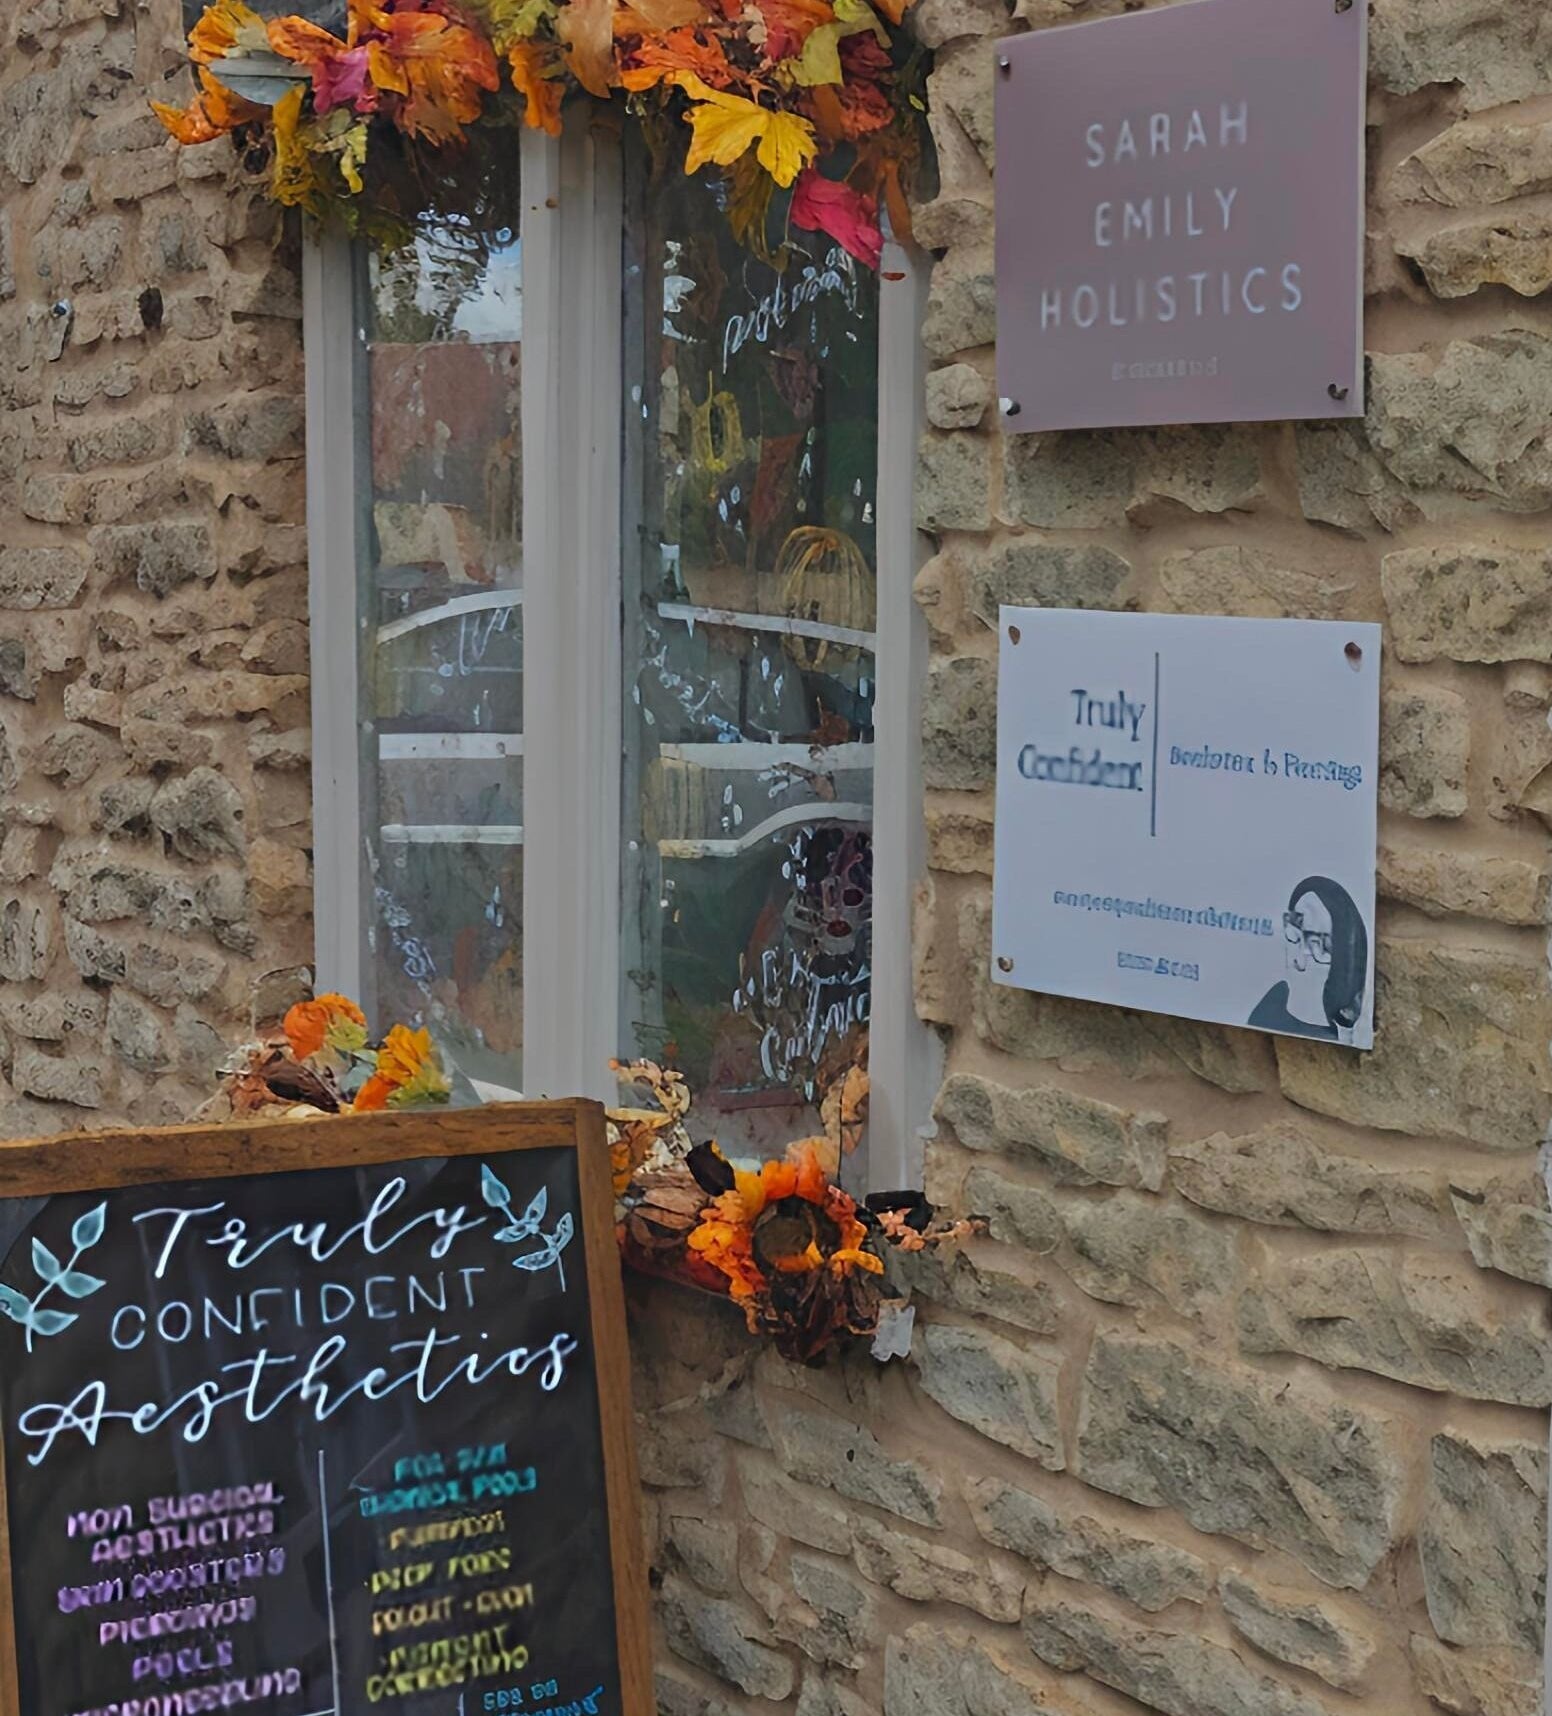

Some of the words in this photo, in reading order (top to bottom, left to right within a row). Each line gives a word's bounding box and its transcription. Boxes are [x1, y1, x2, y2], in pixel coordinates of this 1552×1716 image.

[1086, 101, 1248, 168] SARAH
[1095, 187, 1238, 247] EMILY
[1040, 263, 1302, 330] HOLISTICS
[1070, 689, 1146, 742] Truly
[133, 1177, 486, 1278] Truly
[111, 1268, 486, 1349] CONFIDENT
[18, 1330, 577, 1466] Aesthetics
